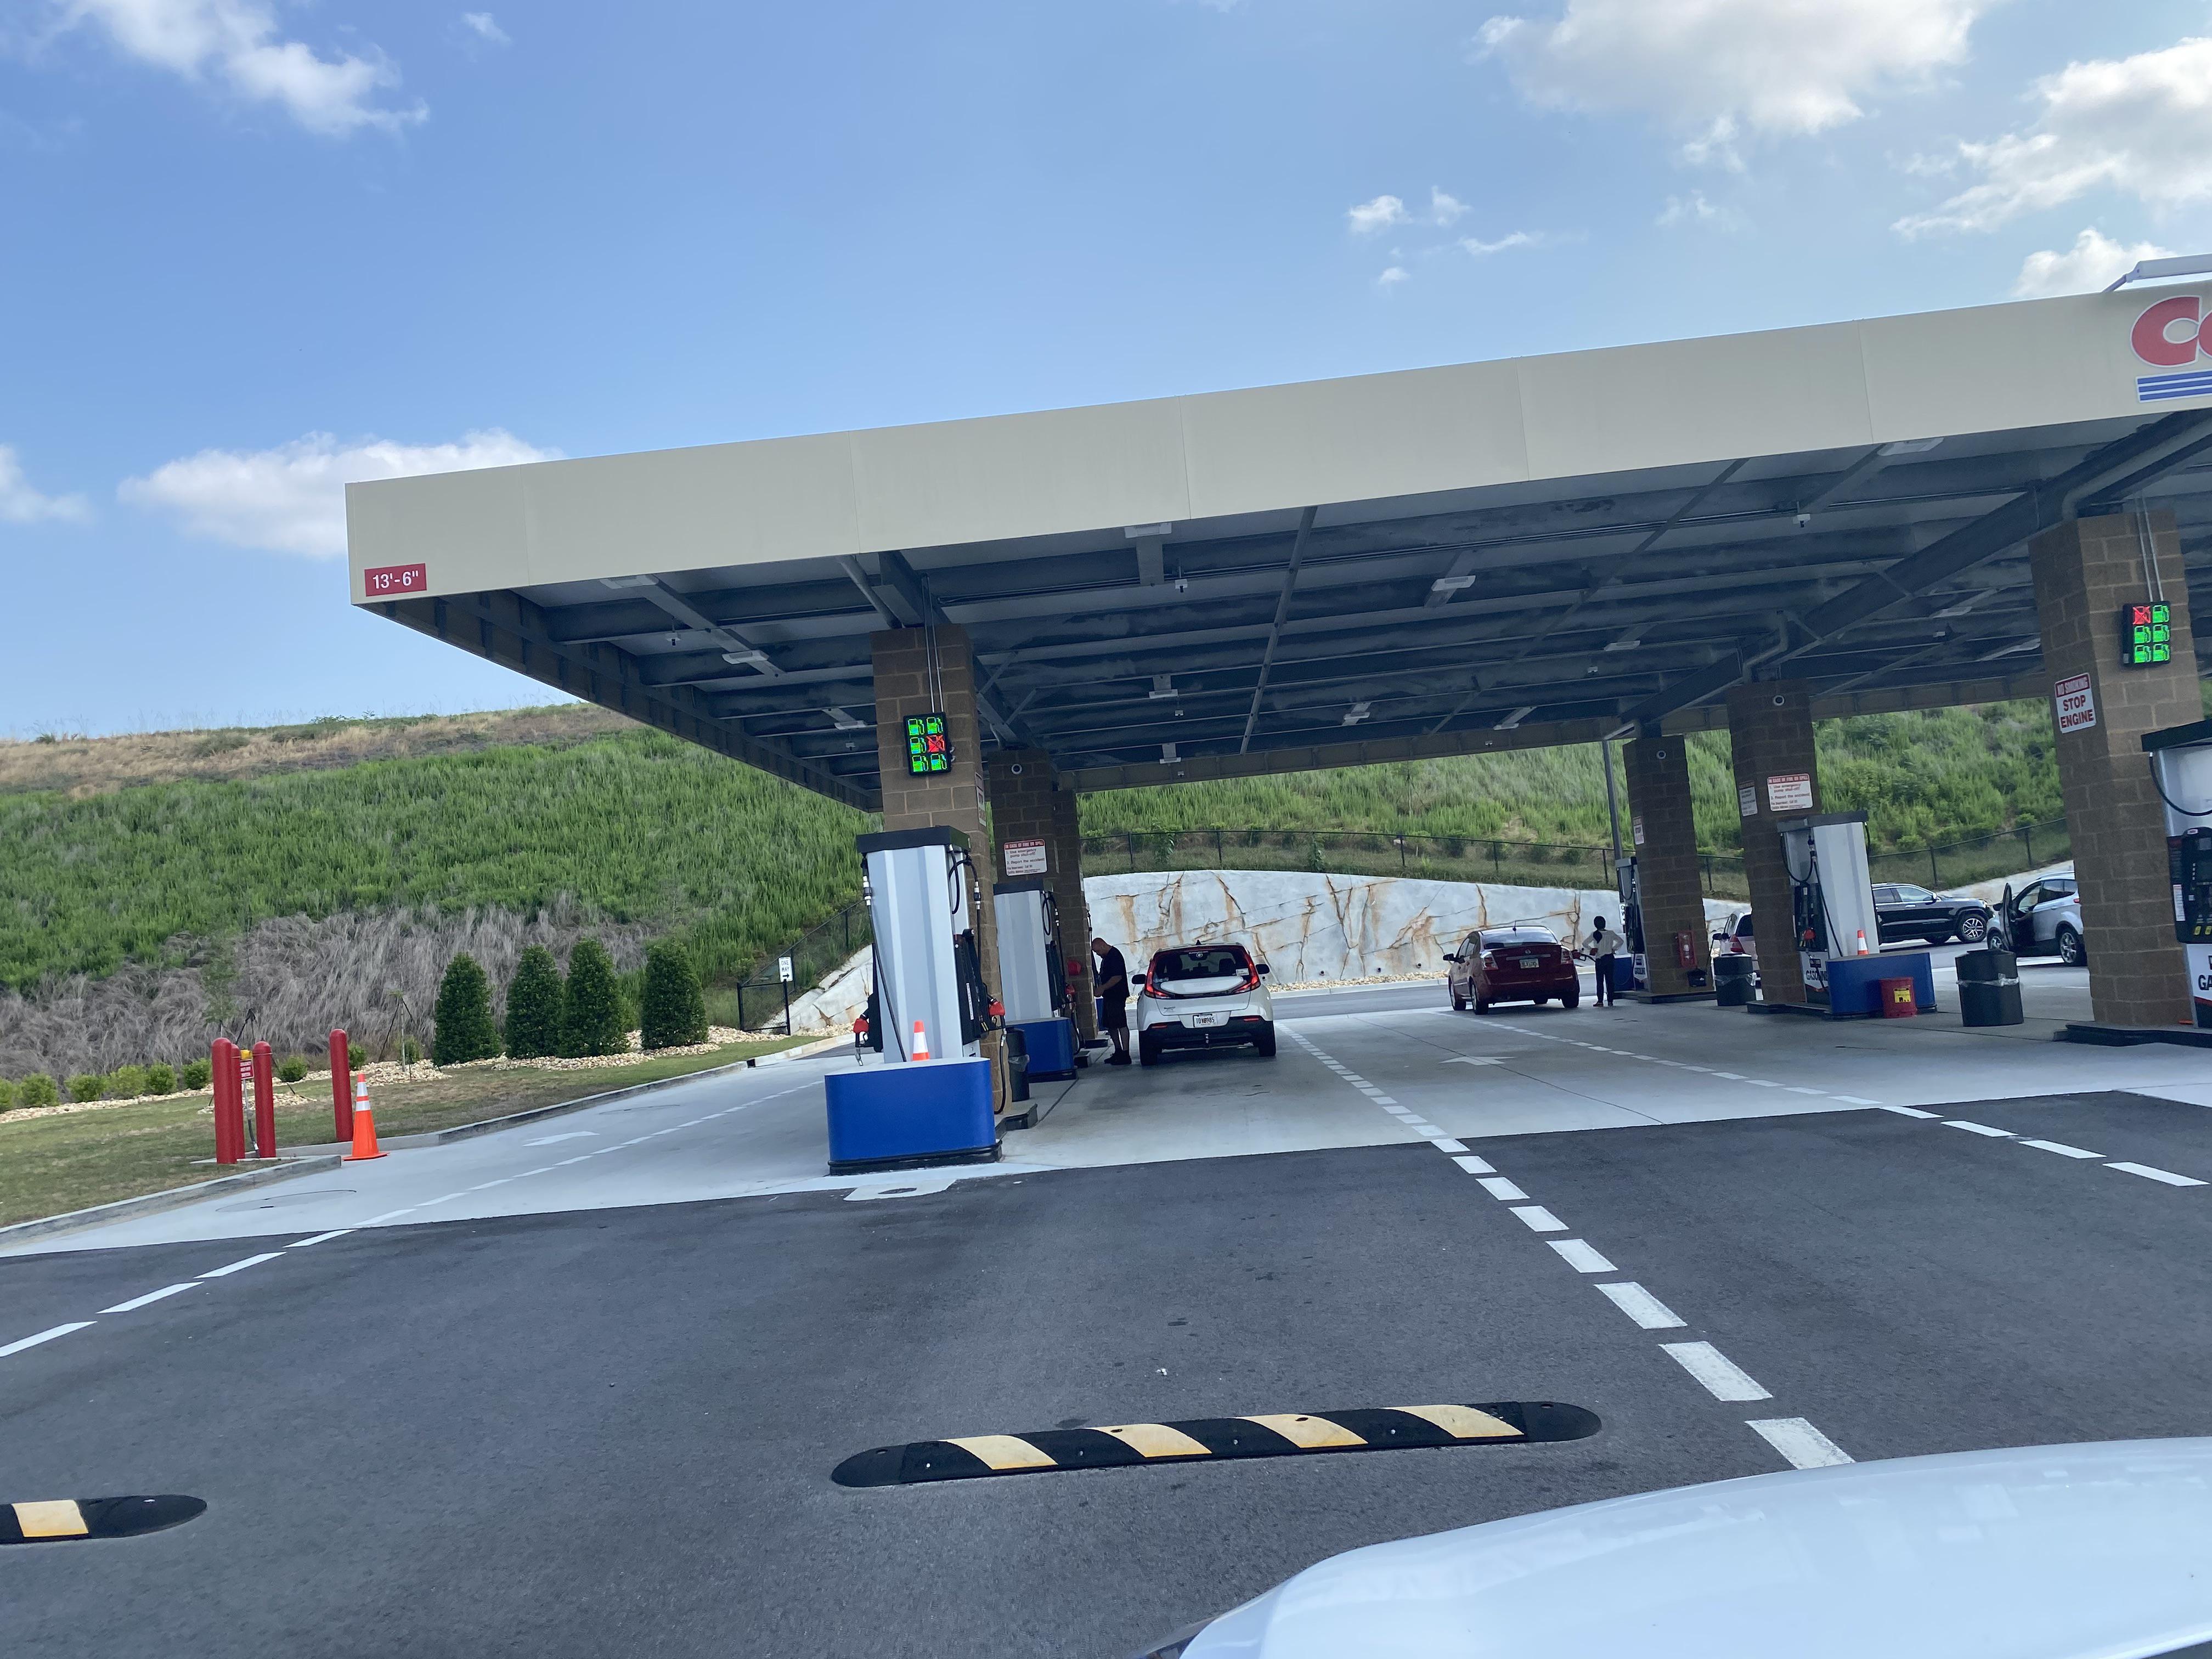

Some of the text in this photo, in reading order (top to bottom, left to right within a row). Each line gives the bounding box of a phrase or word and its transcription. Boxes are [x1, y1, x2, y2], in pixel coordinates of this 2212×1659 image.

[2130, 295, 2212, 368] C
[373, 570, 419, 589] 13'-6"
[2063, 695, 2086, 712] STOP
[2060, 709, 2094, 728] ENGINE
